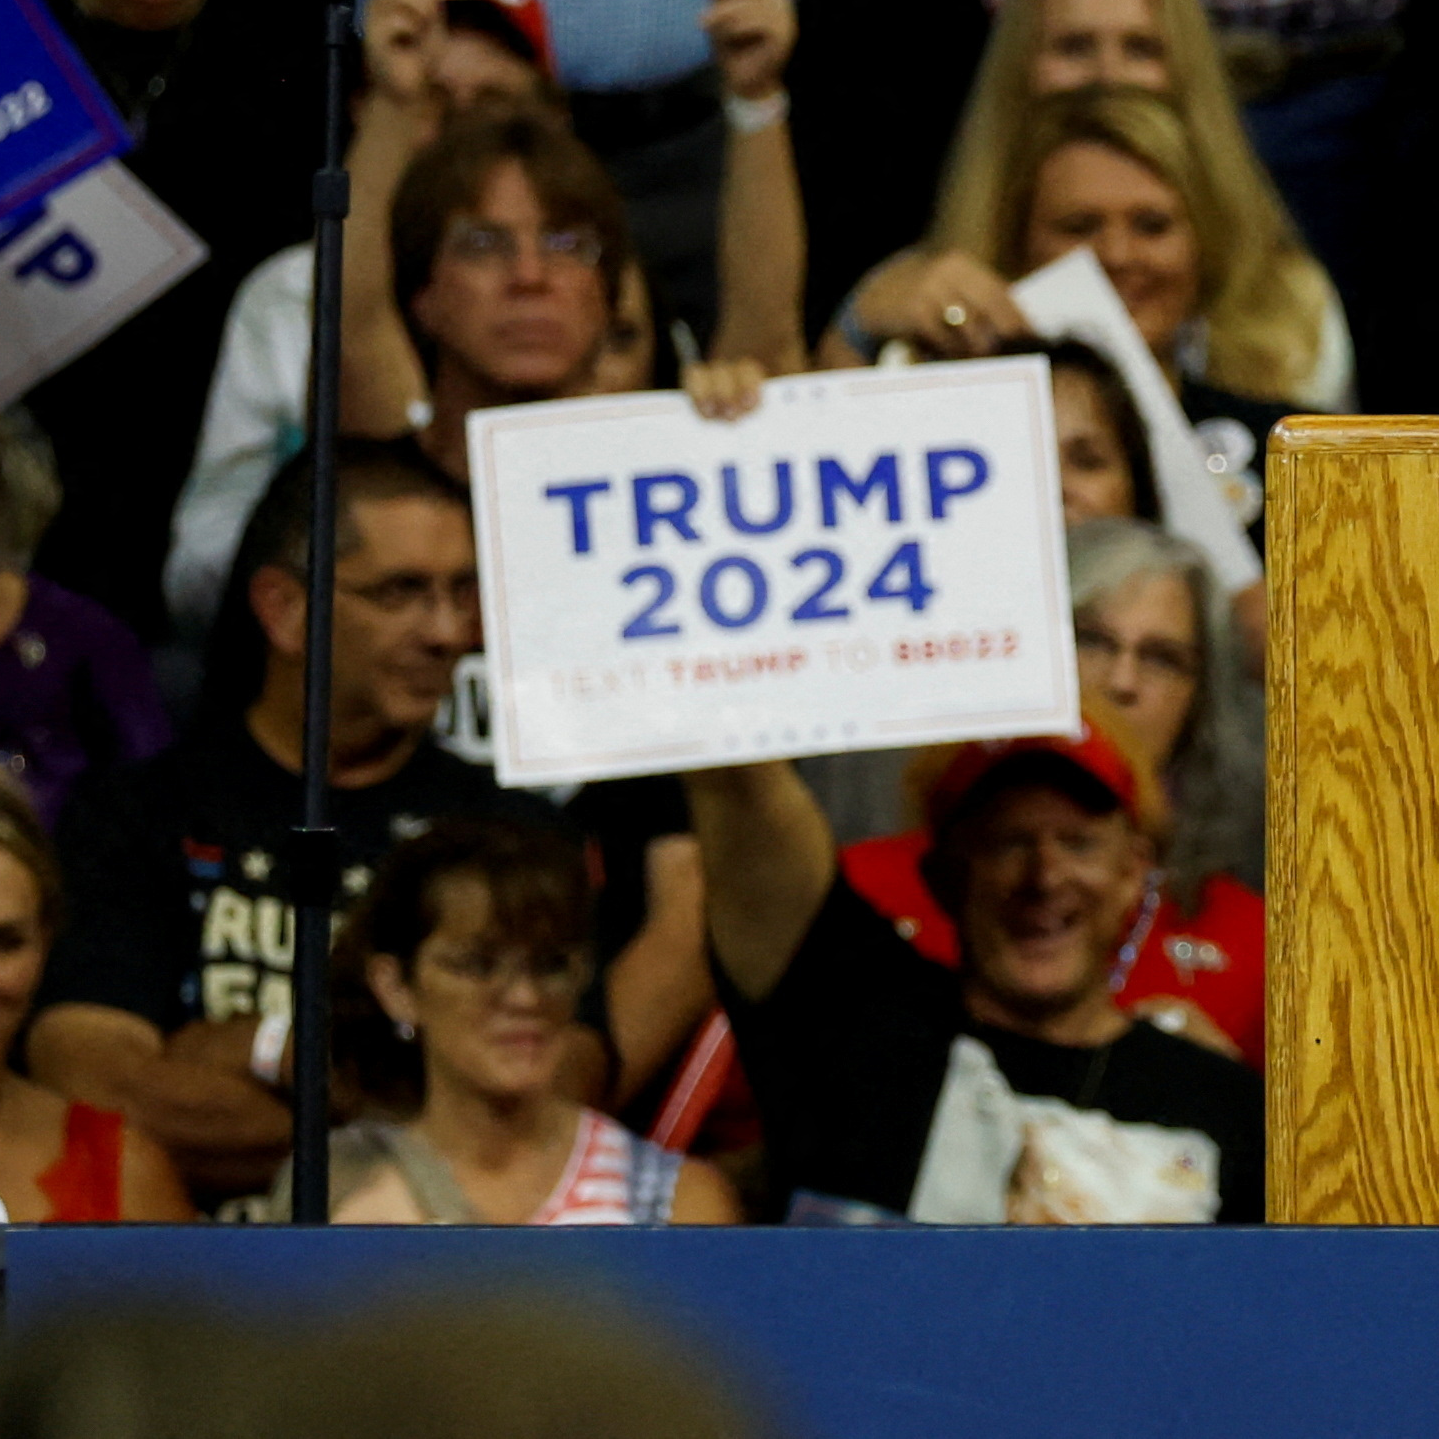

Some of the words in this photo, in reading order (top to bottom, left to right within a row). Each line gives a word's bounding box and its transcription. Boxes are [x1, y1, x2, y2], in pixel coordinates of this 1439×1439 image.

[544, 447, 989, 555] TRUMP
[620, 541, 935, 640] 2024
[667, 647, 809, 684] TRUMP
[825, 639, 880, 674] TO
